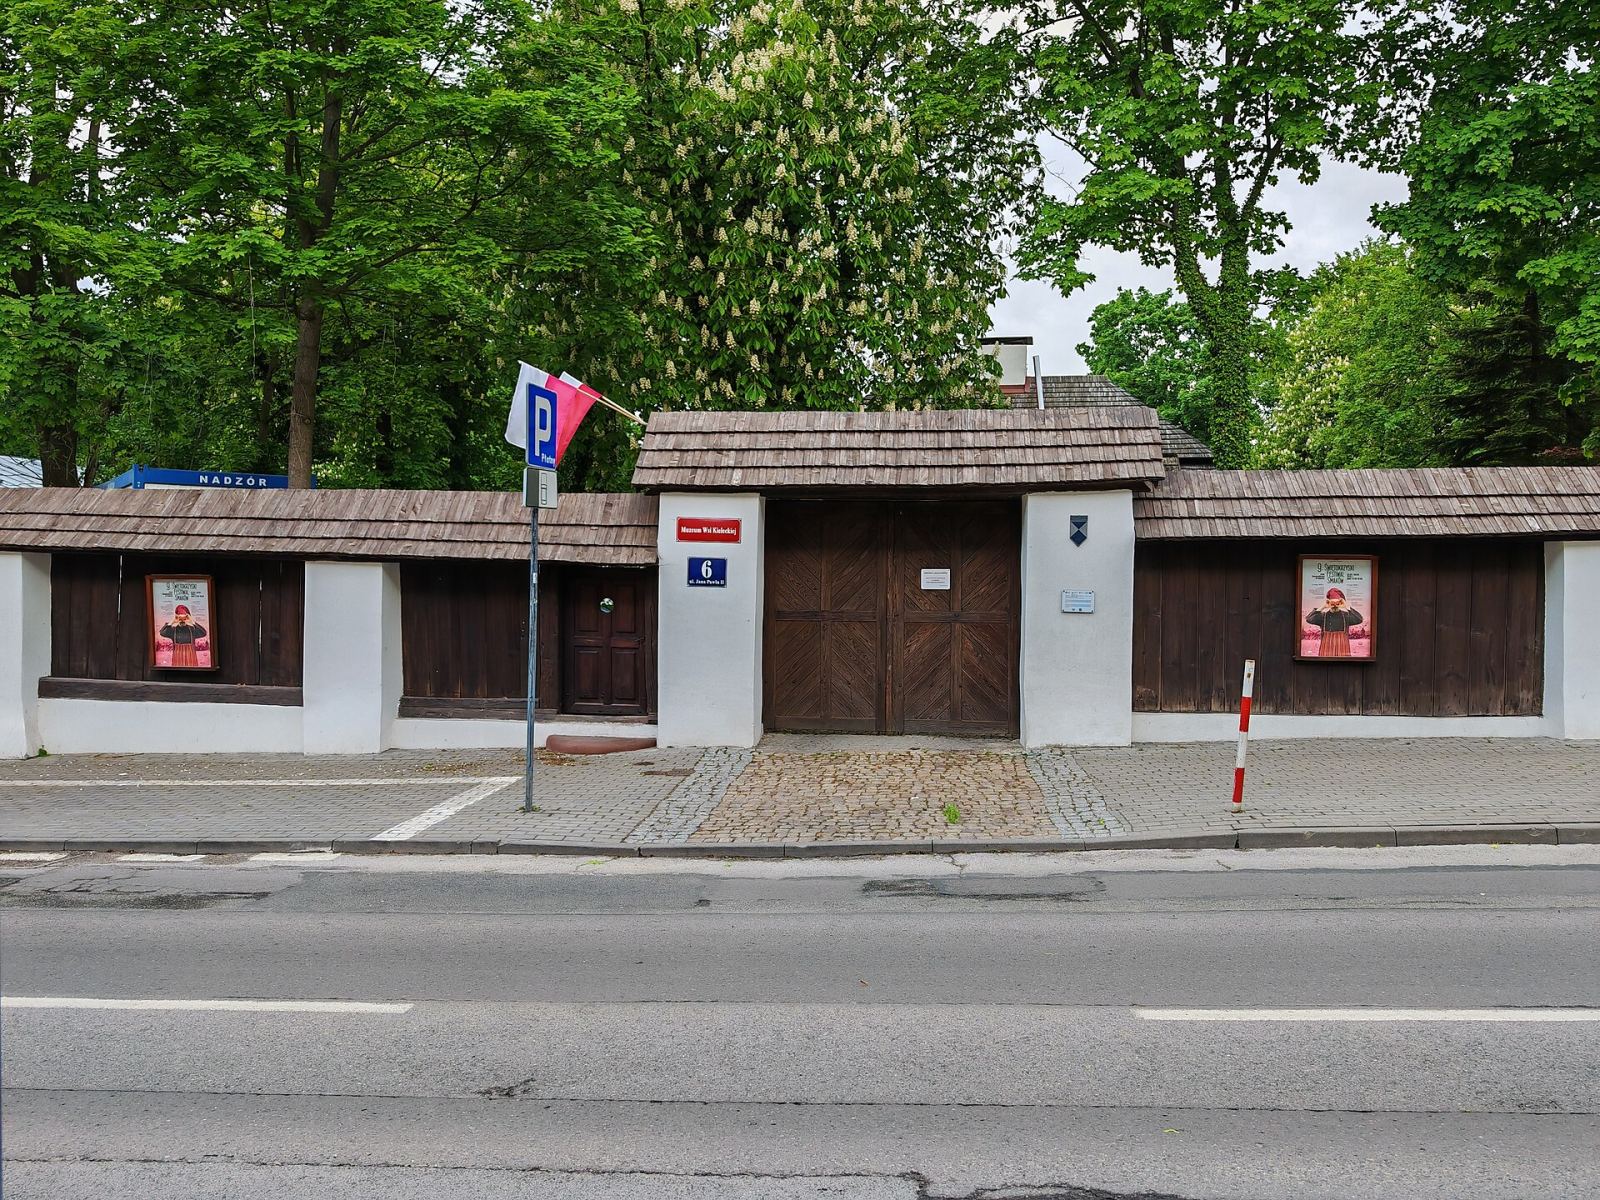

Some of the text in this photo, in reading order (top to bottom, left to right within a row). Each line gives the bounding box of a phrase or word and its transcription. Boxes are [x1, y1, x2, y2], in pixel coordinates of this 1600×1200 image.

[535, 395, 551, 456] P
[199, 475, 267, 487] NADZÓR
[681, 526, 737, 536] Muzeum Wsi Kieleckiej
[701, 560, 712, 579] 6
